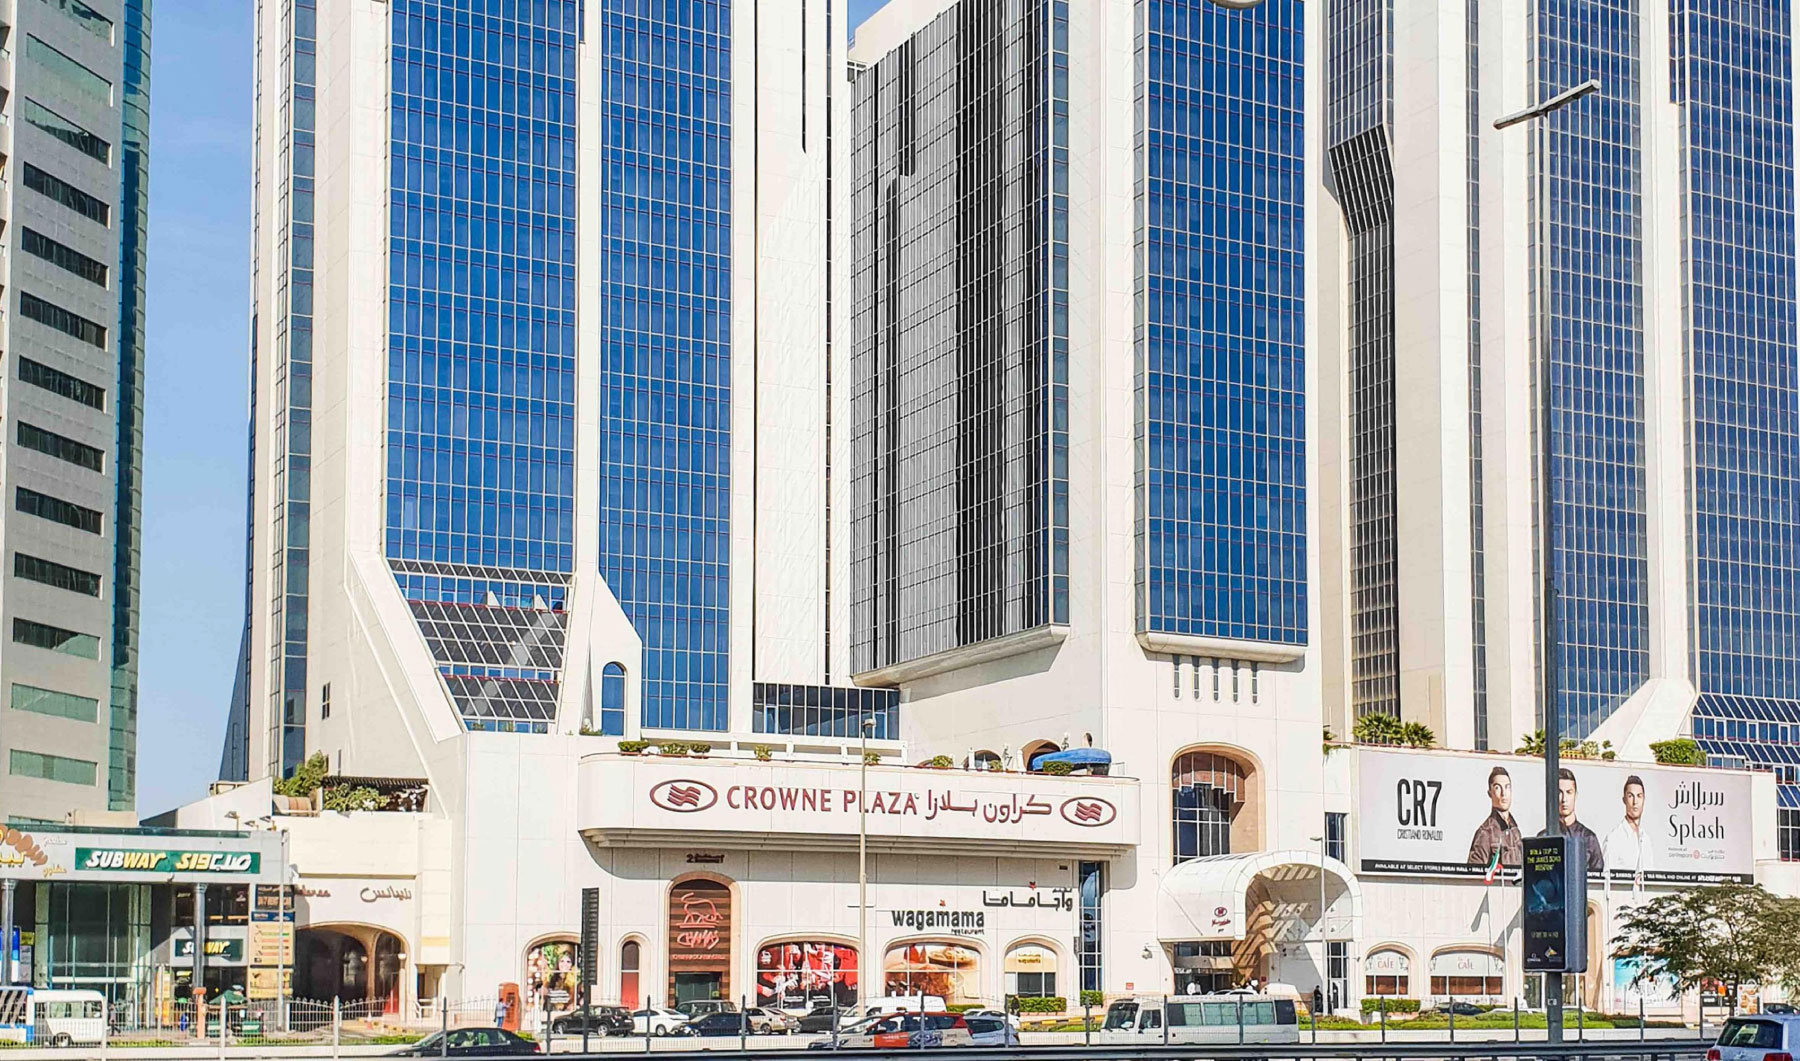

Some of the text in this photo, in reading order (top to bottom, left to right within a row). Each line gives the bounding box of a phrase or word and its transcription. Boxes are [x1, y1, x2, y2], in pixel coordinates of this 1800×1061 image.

[726, 785, 918, 816] CROWNE PLAZA
[925, 789, 1052, 823] كراون بلازا
[1397, 778, 1442, 827] CR7
[1668, 780, 1724, 811] سبلاش
[1422, 829, 1443, 841] RONALDO
[1668, 814, 1724, 845] Splash
[85, 851, 167, 869] SUBWAY
[892, 910, 985, 931] wagamama
[951, 928, 985, 936] restaurant
